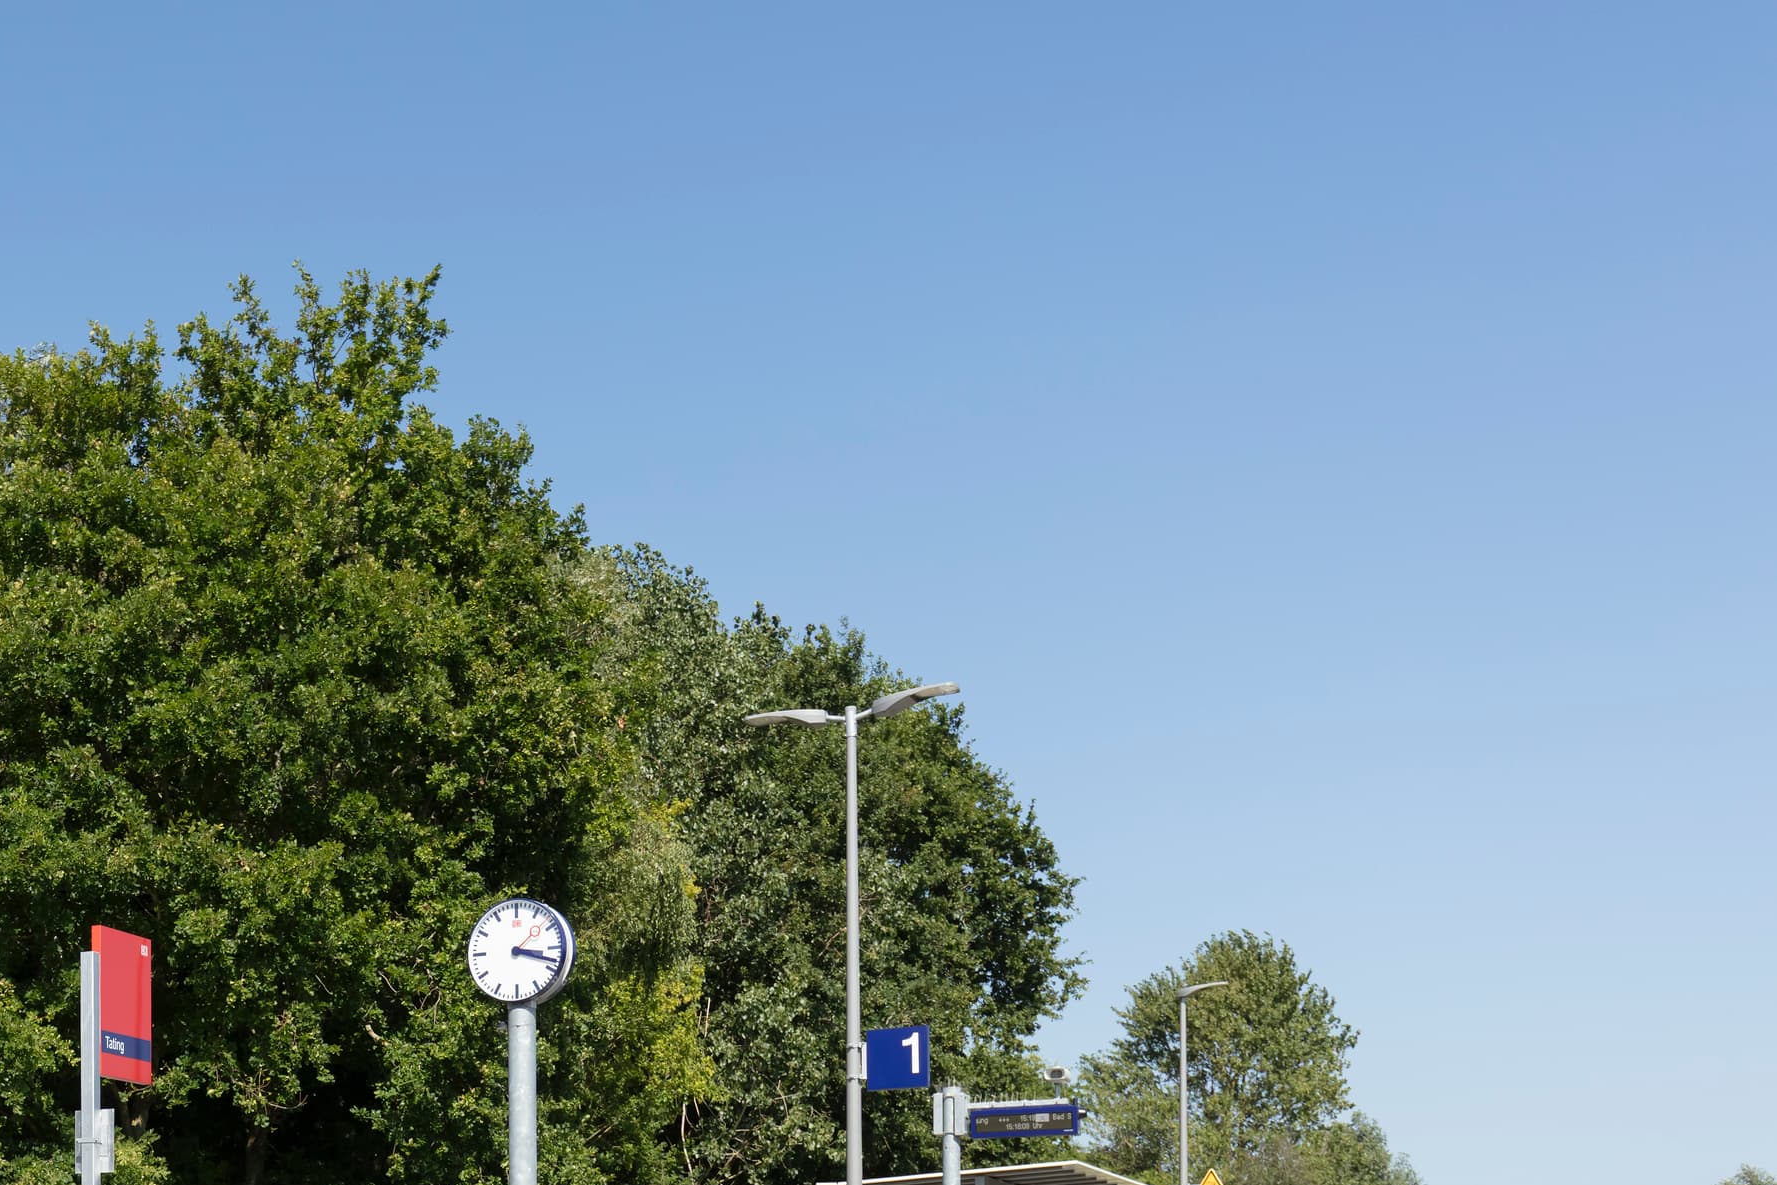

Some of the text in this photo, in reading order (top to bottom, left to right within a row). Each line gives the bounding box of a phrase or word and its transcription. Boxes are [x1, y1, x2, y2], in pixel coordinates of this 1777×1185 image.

[105, 1035, 125, 1054] Tating
[902, 1032, 920, 1074] 1
[1052, 1112, 1065, 1120] Bad
